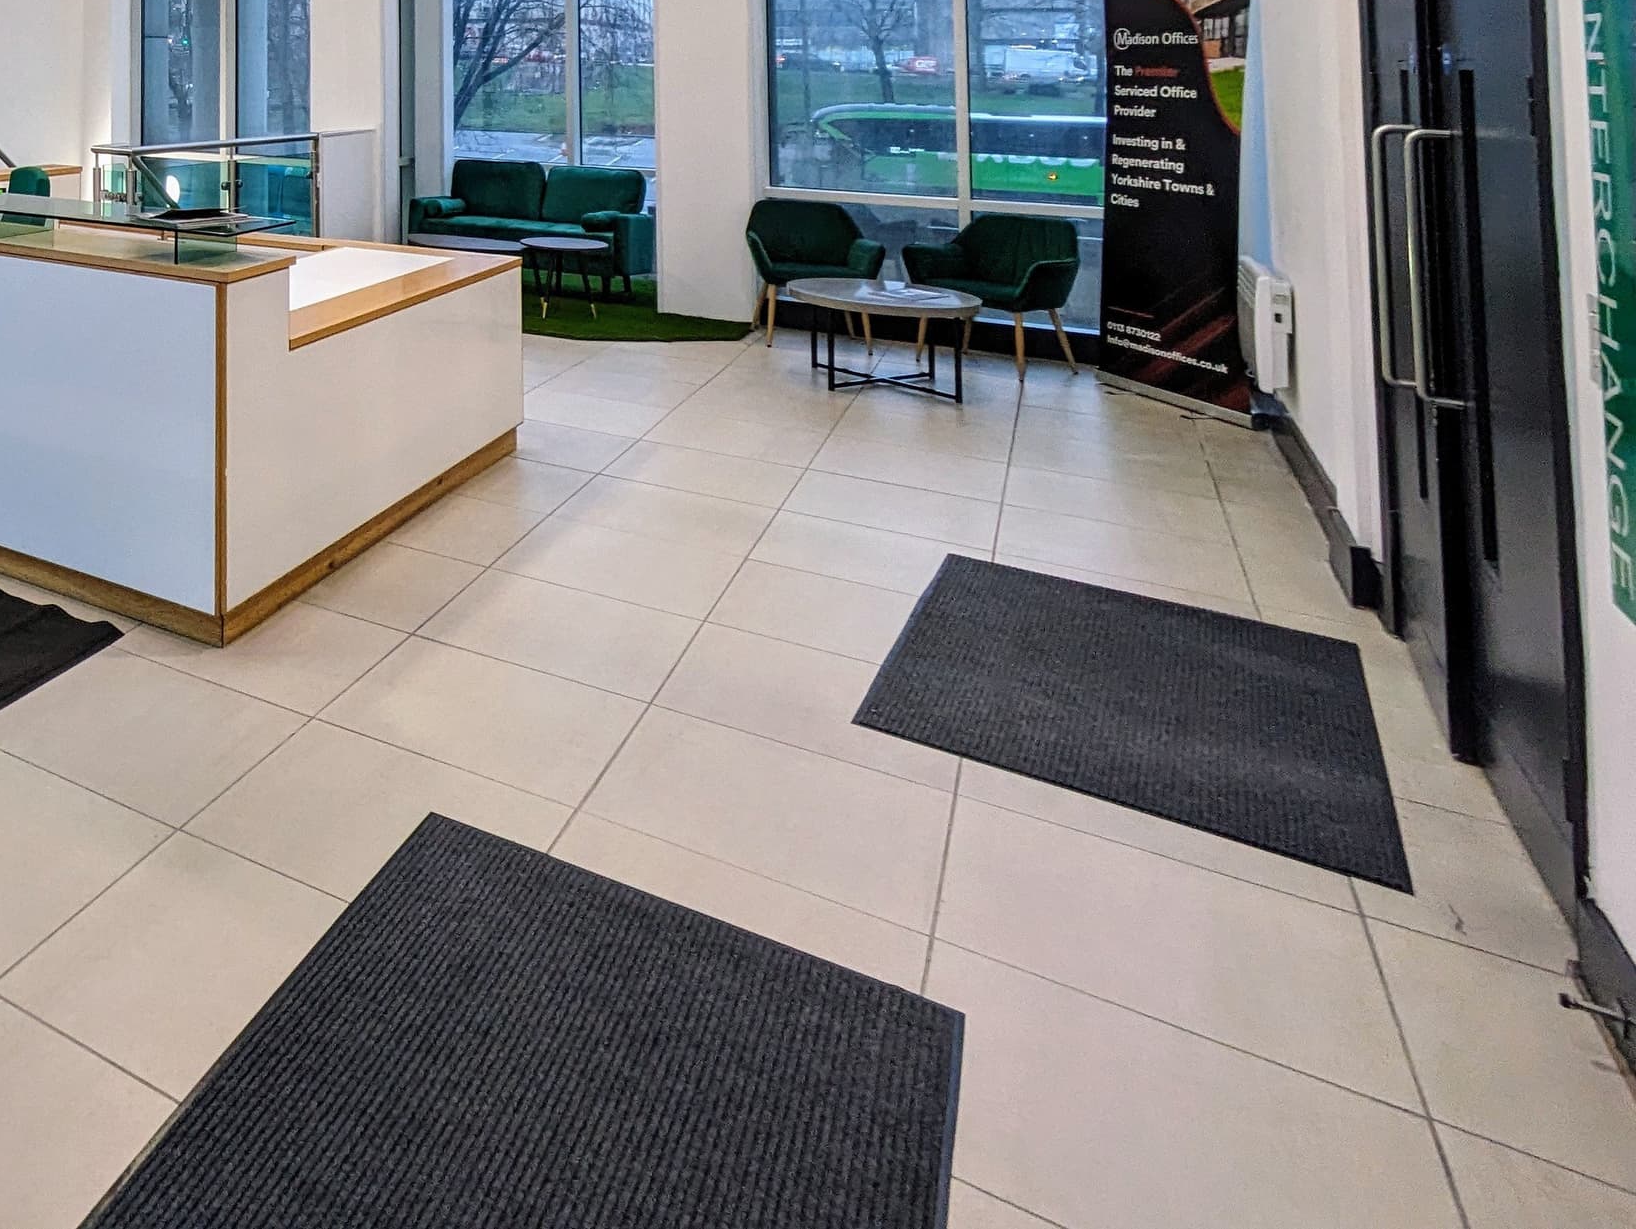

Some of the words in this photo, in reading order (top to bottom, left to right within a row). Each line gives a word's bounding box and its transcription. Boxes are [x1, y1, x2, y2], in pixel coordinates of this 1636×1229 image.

[1113, 27, 1160, 50] Madison
[1161, 32, 1199, 45] Offices
[1113, 65, 1134, 77] The
[1114, 84, 1158, 98] Serviced
[1159, 85, 1198, 99] Office
[1113, 104, 1157, 118] Provider
[1112, 134, 1160, 151] Investing
[1161, 137, 1173, 150] in
[1175, 138, 1186, 151] &
[1111, 153, 1185, 174] Regenerating
[1111, 173, 1162, 190] Yorkshire
[1162, 179, 1205, 195] Towns
[1205, 183, 1216, 196] &
[1110, 193, 1140, 208] Cities
